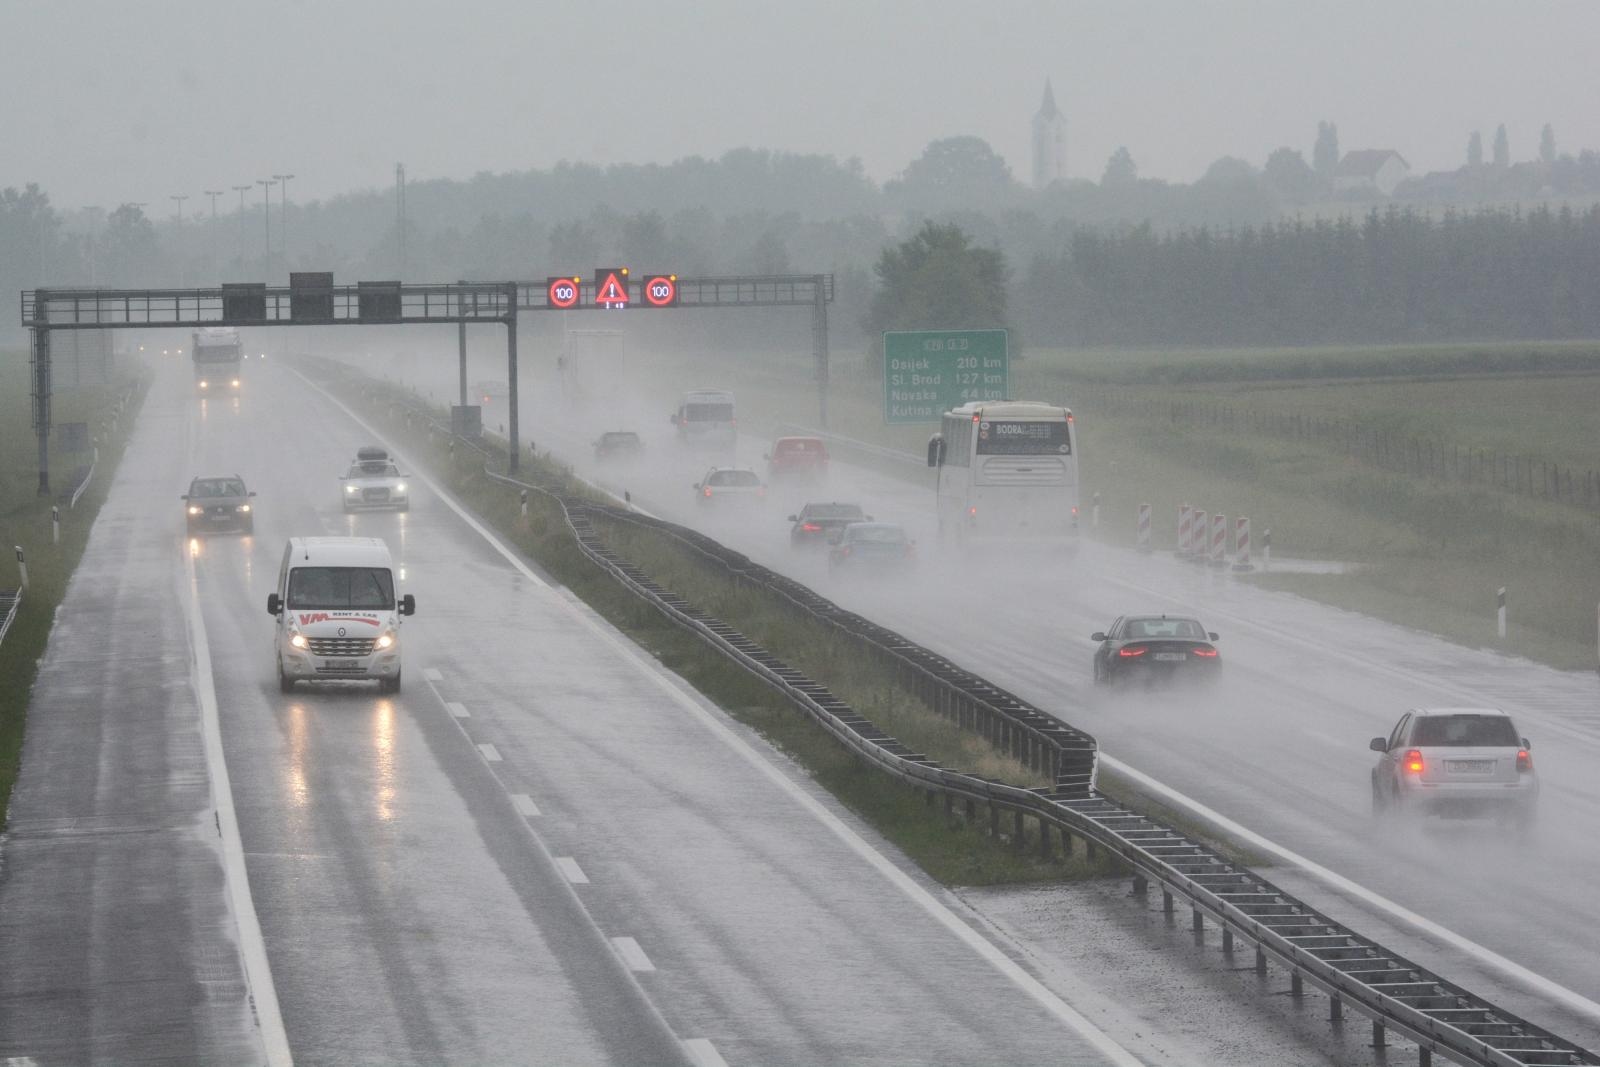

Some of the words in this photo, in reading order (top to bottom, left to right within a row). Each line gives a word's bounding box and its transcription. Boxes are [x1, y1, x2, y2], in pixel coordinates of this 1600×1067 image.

[555, 288, 573, 299] 100
[651, 286, 669, 297] 100
[891, 358, 929, 371] Osijek
[957, 358, 977, 369] 210
[983, 357, 1001, 368] km
[911, 374, 941, 385] Brod
[956, 373, 979, 384] 127
[983, 373, 1002, 384] km
[891, 390, 937, 401] Novska
[961, 389, 978, 399] 44
[984, 388, 1002, 399] km
[892, 404, 932, 416] Kutina
